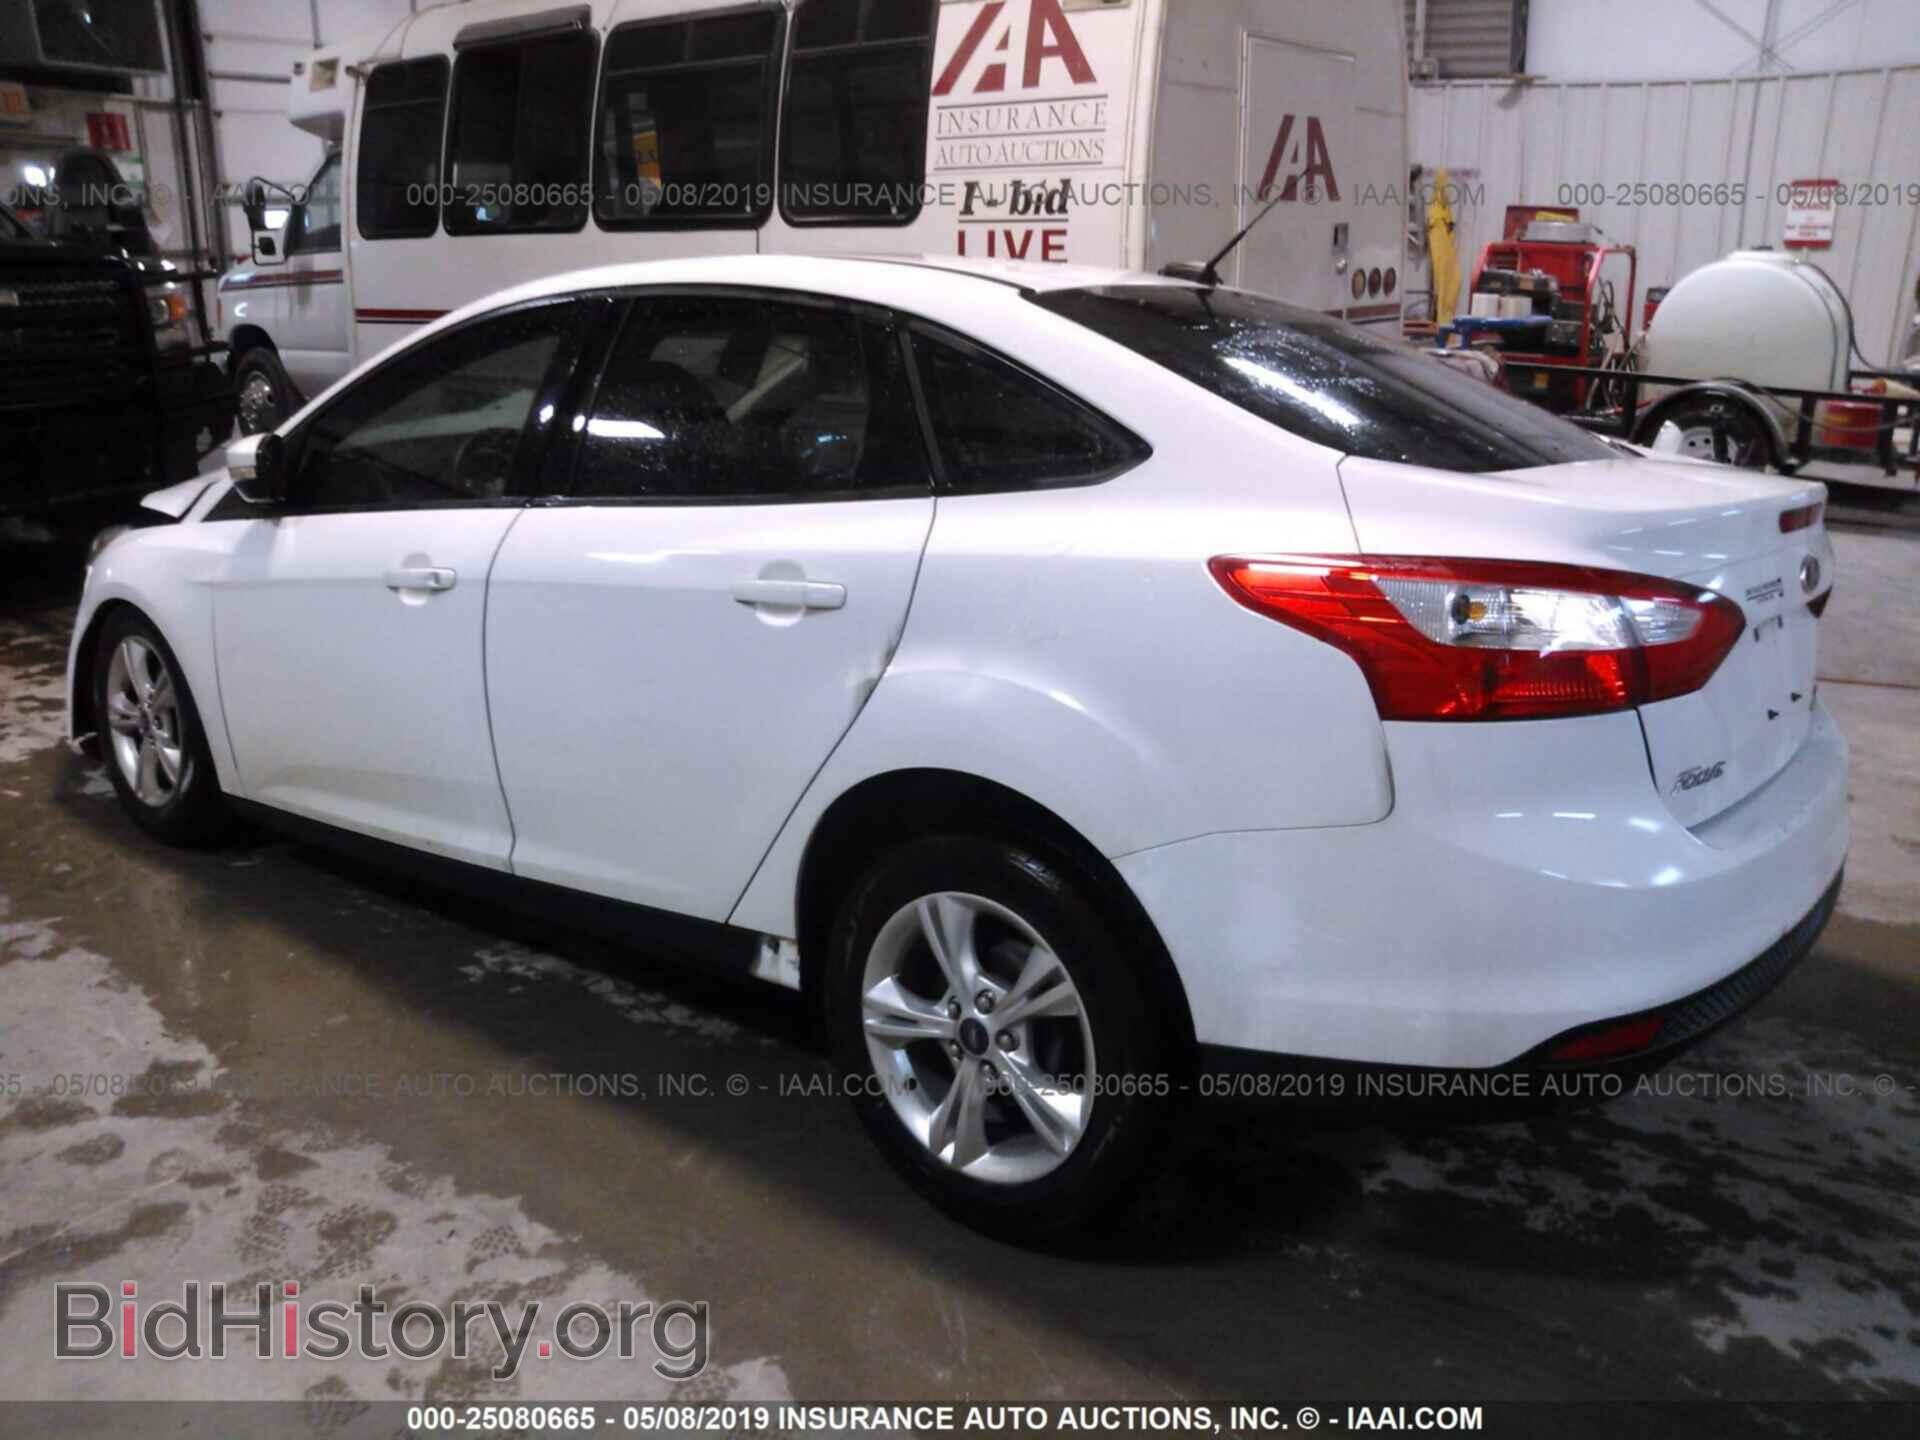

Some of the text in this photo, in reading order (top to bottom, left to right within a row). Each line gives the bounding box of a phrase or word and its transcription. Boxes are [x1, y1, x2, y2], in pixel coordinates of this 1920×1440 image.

[936, 101, 1108, 134] INSURANCE
[935, 136, 1105, 166] AUTO AUCTIONS
